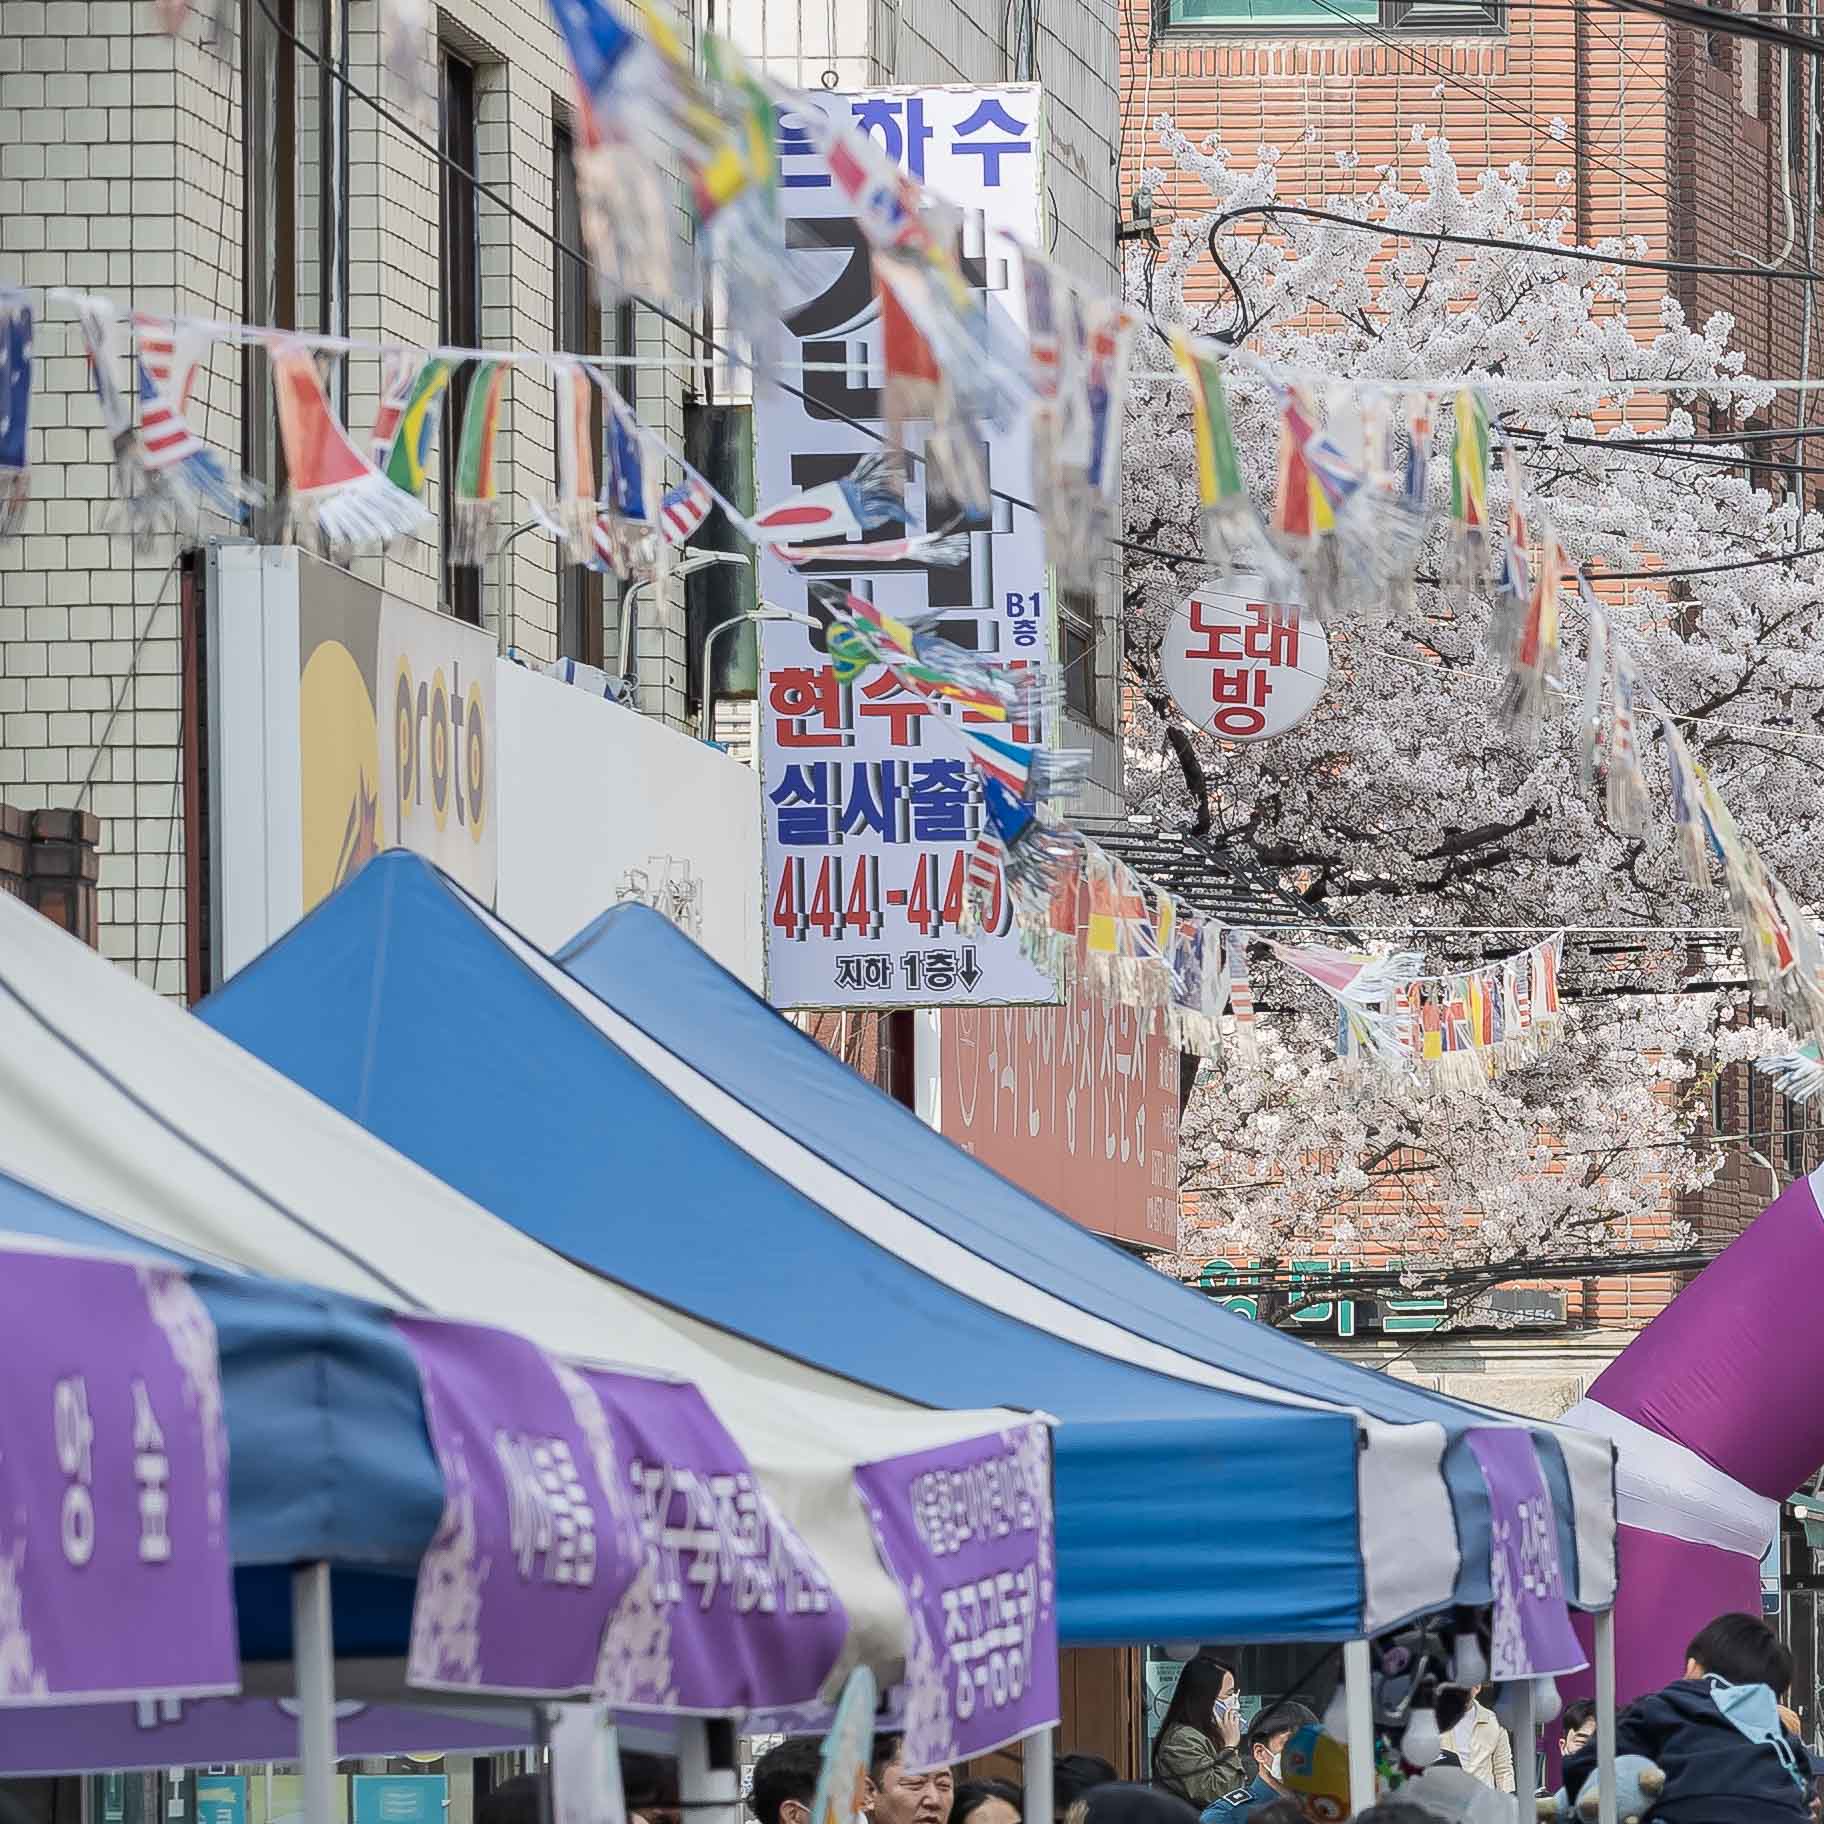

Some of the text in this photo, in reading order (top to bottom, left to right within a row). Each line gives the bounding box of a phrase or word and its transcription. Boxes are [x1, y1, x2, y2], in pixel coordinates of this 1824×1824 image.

[1005, 592, 1041, 619] B1
[1011, 621, 1038, 647] 층
[1185, 600, 1299, 668] 노래
[1213, 668, 1273, 736] 방
[395, 660, 484, 845] proto
[768, 757, 1035, 847] 실사출
[772, 848, 1012, 939] 444-44
[836, 950, 955, 990] 지하 1층
